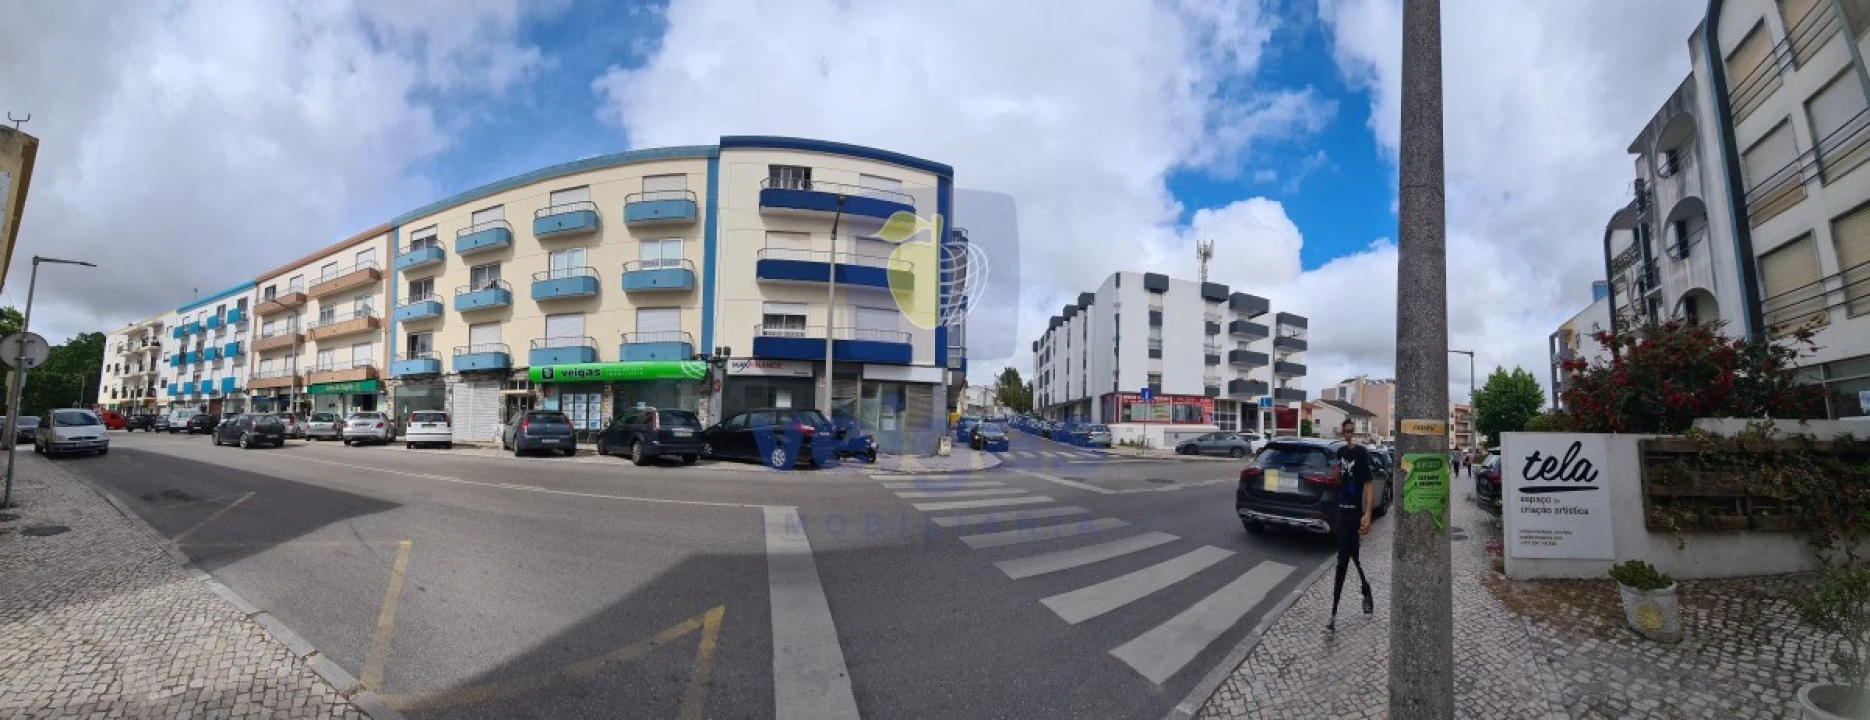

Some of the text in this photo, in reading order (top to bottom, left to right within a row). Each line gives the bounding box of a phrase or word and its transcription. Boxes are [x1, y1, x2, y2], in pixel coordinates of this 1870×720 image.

[561, 367, 601, 378] veigas
[1522, 441, 1599, 482] tela
[1520, 496, 1552, 505] espaço
